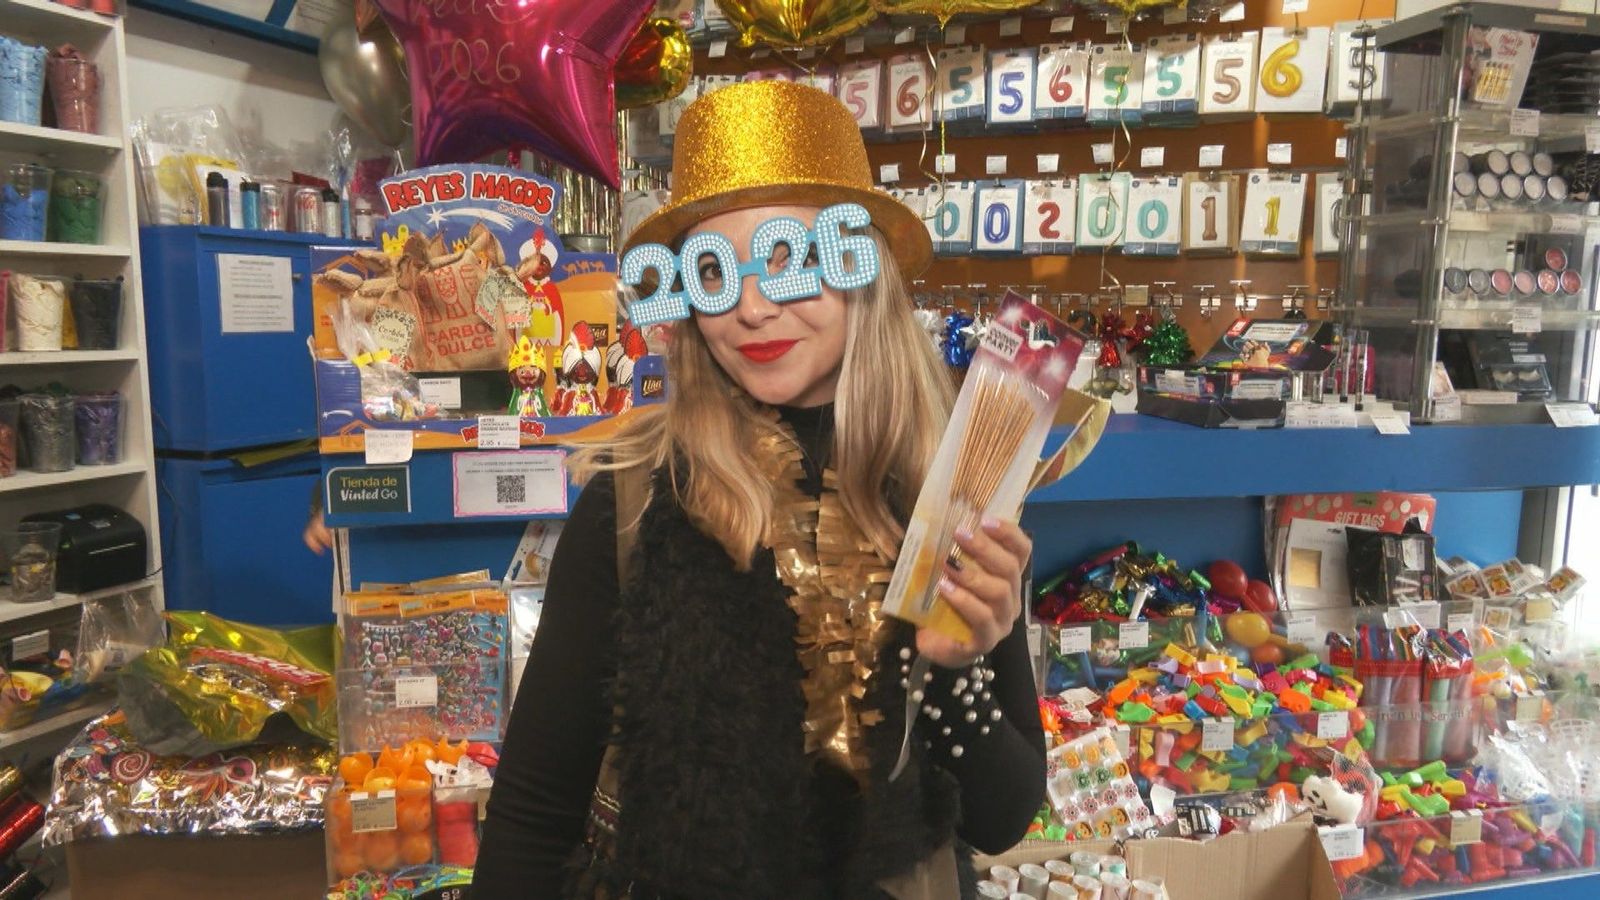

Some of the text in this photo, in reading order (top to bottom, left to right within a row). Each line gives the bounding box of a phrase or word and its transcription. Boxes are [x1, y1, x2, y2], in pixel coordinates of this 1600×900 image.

[949, 66, 973, 105] 5
[1050, 64, 1073, 103] 6
[1104, 66, 1129, 105] 5
[1157, 55, 1185, 97] 5
[1213, 58, 1244, 104] 5
[1261, 38, 1303, 97] 6
[846, 81, 869, 120] 5
[896, 75, 920, 117] 6
[998, 72, 1025, 115] 5
[382, 172, 553, 214] REYES MAGOS
[934, 201, 960, 238] 0
[984, 202, 1011, 244] 0
[1038, 201, 1061, 239] 2
[1088, 196, 1117, 239] 0
[1137, 199, 1169, 240] 0
[1201, 196, 1218, 241] 1
[1263, 196, 1281, 238] 1
[621, 203, 880, 327] 2026
[428, 322, 488, 343] CARBO
[437, 335, 496, 357] DULCE
[340, 475, 398, 488] Tienda de
[340, 488, 398, 501] Vinted Go
[1334, 511, 1386, 528] GIFT TAGS
